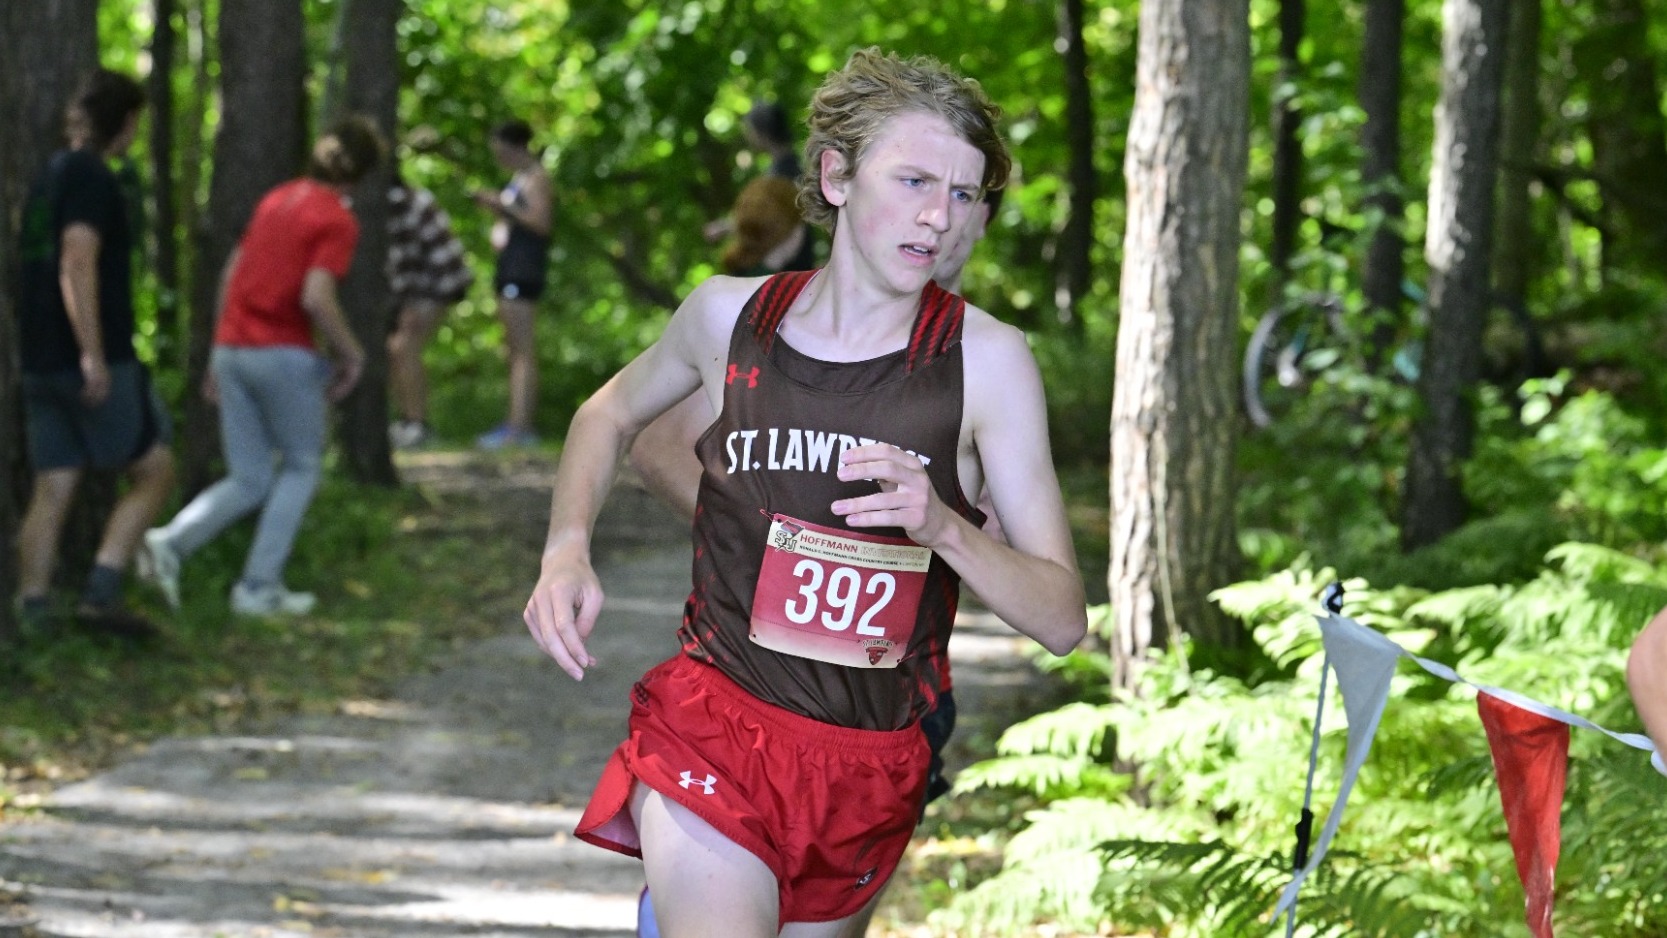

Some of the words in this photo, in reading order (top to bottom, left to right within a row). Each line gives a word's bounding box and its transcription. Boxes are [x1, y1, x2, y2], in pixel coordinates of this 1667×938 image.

[726, 429, 760, 474] ST.
[800, 533, 858, 553] HOFFMANN
[785, 559, 896, 637] 392
